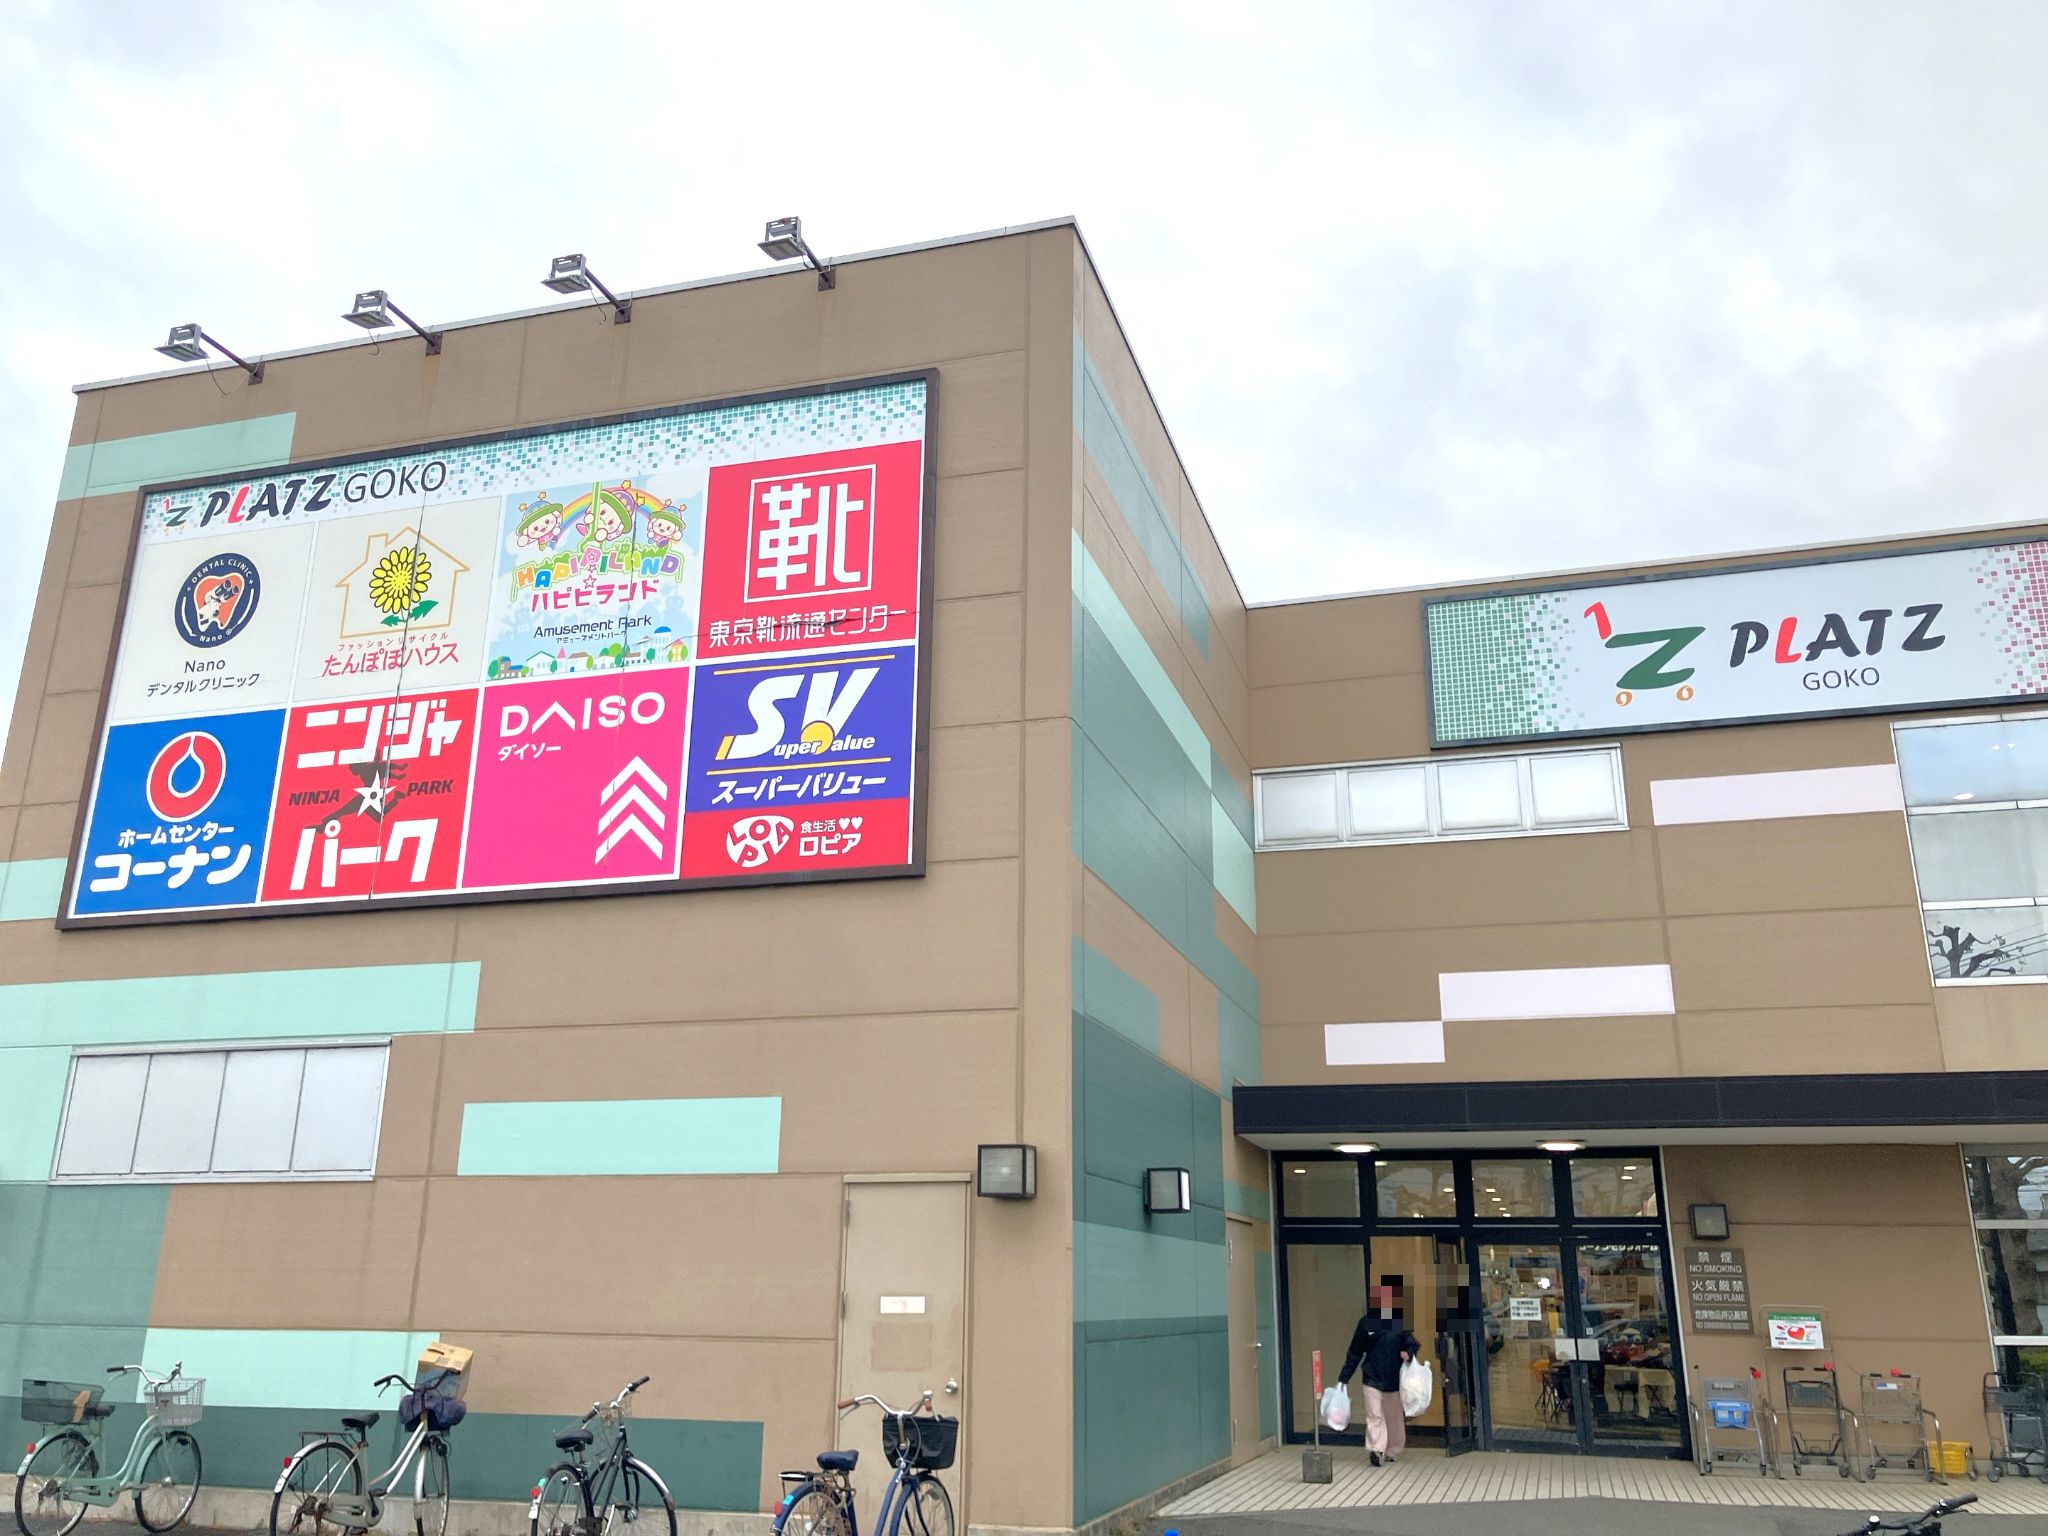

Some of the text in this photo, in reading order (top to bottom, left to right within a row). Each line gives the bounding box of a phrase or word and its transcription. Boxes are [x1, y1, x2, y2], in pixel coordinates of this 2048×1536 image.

[200, 473, 337, 528] PLATZ
[343, 460, 447, 504] GOKO
[756, 482, 865, 591] 靴
[192, 558, 253, 583] DENTAL CLINIC
[199, 634, 222, 643] Nano
[533, 614, 652, 639] Amusement Park
[708, 605, 907, 649] 東京靴流通センター
[1729, 603, 1946, 668] PLATZ
[184, 659, 226, 674] Nano
[321, 642, 459, 677] たんぽぽハウス
[147, 673, 260, 698] デンタルクリニック
[1803, 667, 1881, 691] GOKO
[499, 691, 666, 738] DAISO
[297, 699, 463, 769] ニンジャ
[498, 742, 562, 762] ダイソー
[288, 779, 454, 807] NINJA PARK
[711, 771, 887, 805] スーパーバリュー
[118, 821, 235, 848] ホームセンター
[800, 819, 836, 834] 食生活
[289, 818, 439, 891] パーク
[799, 833, 862, 857] ロピア
[89, 844, 252, 893] コーナン
[1689, 1264, 1743, 1273] NO SMOKING
[1692, 1293, 1703, 1301] NO
[1703, 1293, 1722, 1302] OPEN
